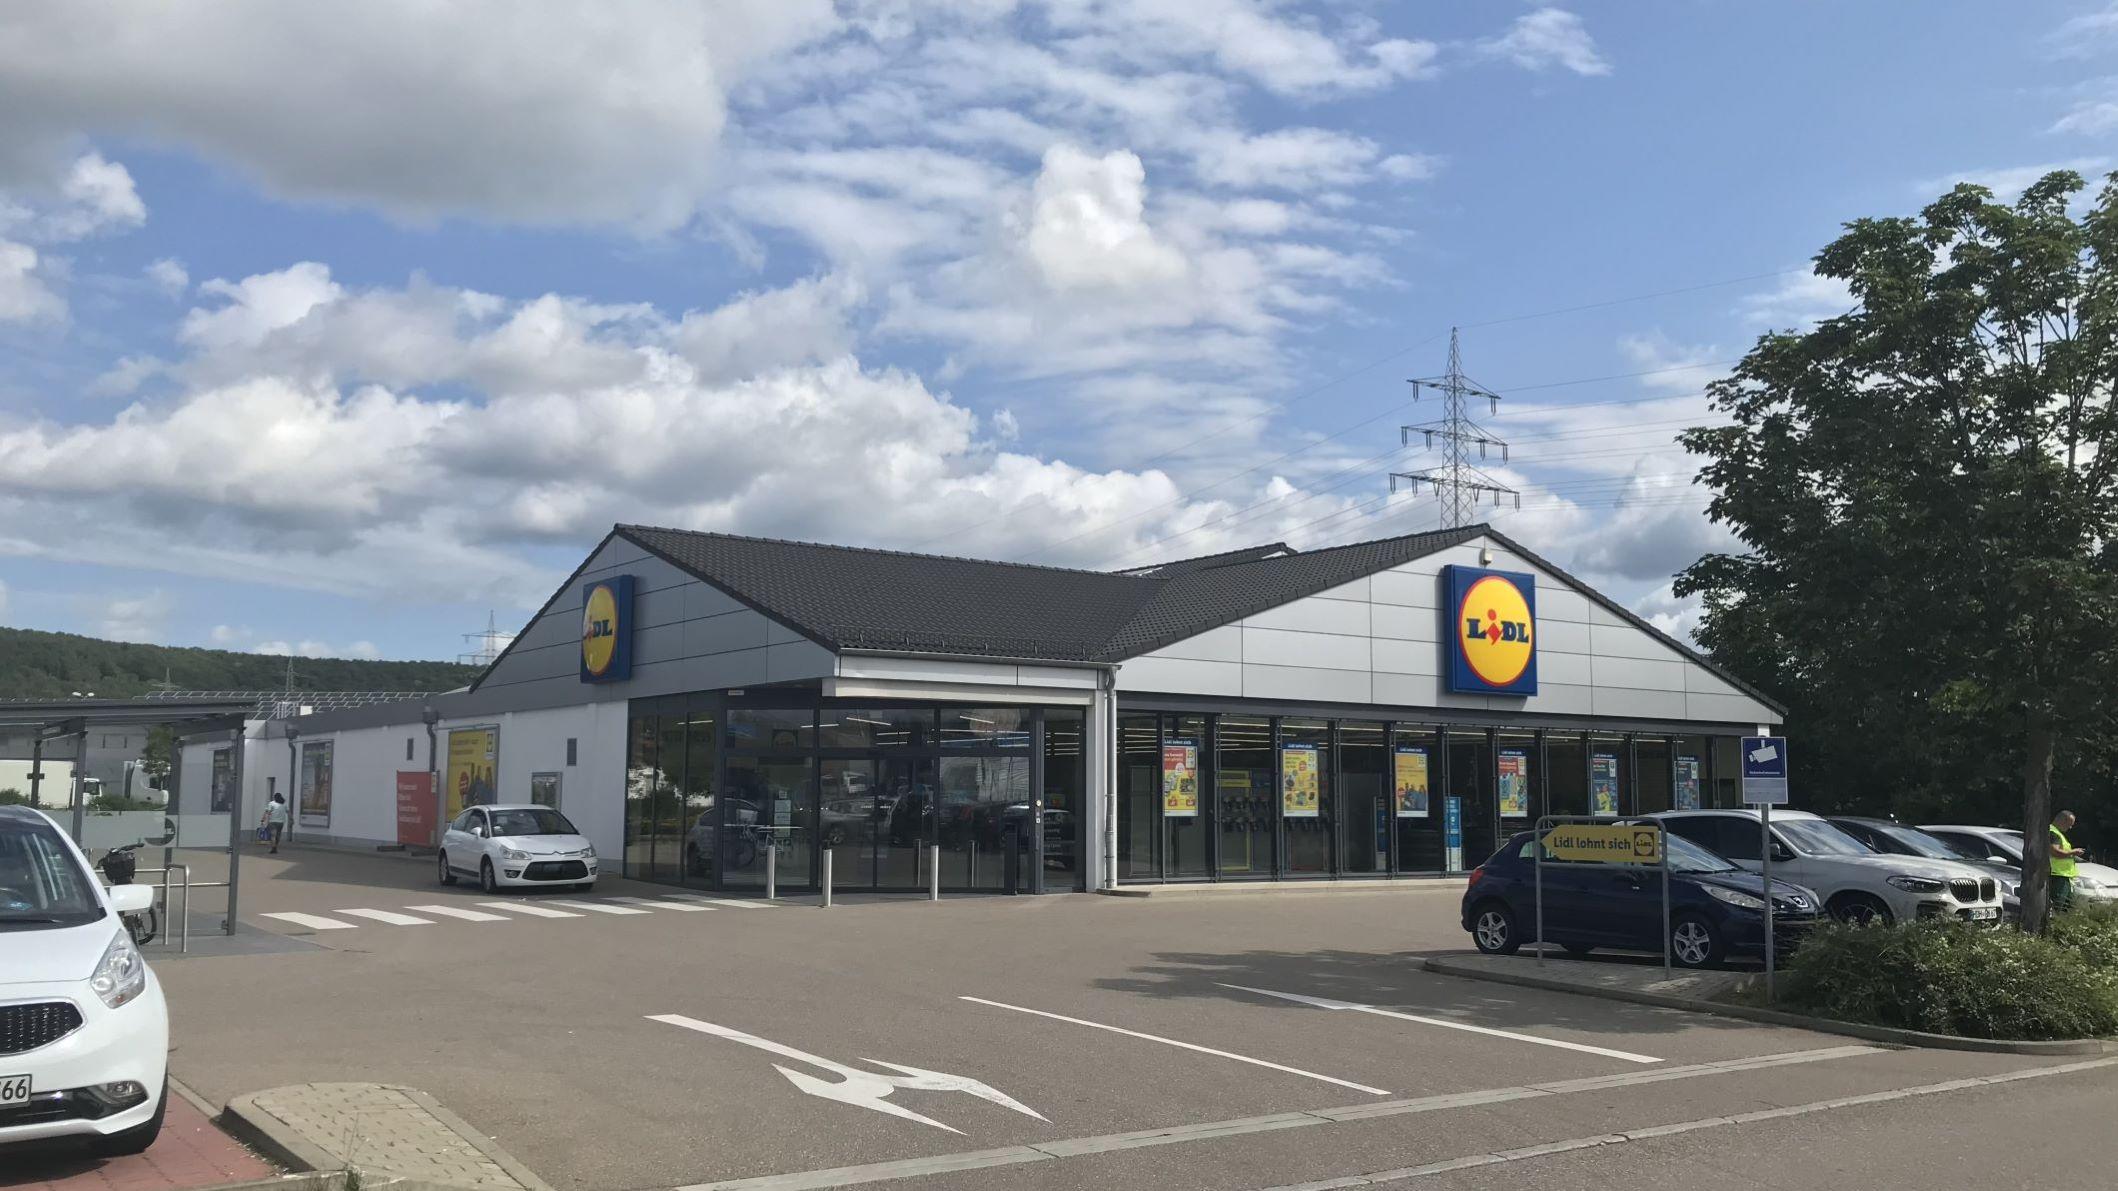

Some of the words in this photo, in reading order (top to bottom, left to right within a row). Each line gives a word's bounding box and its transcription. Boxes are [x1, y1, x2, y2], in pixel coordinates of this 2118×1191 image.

[1553, 836, 1574, 849] Lidl
[1576, 836, 1605, 849] lohnt
[1608, 837, 1631, 850] sich
[0, 1078, 27, 1101] 66
